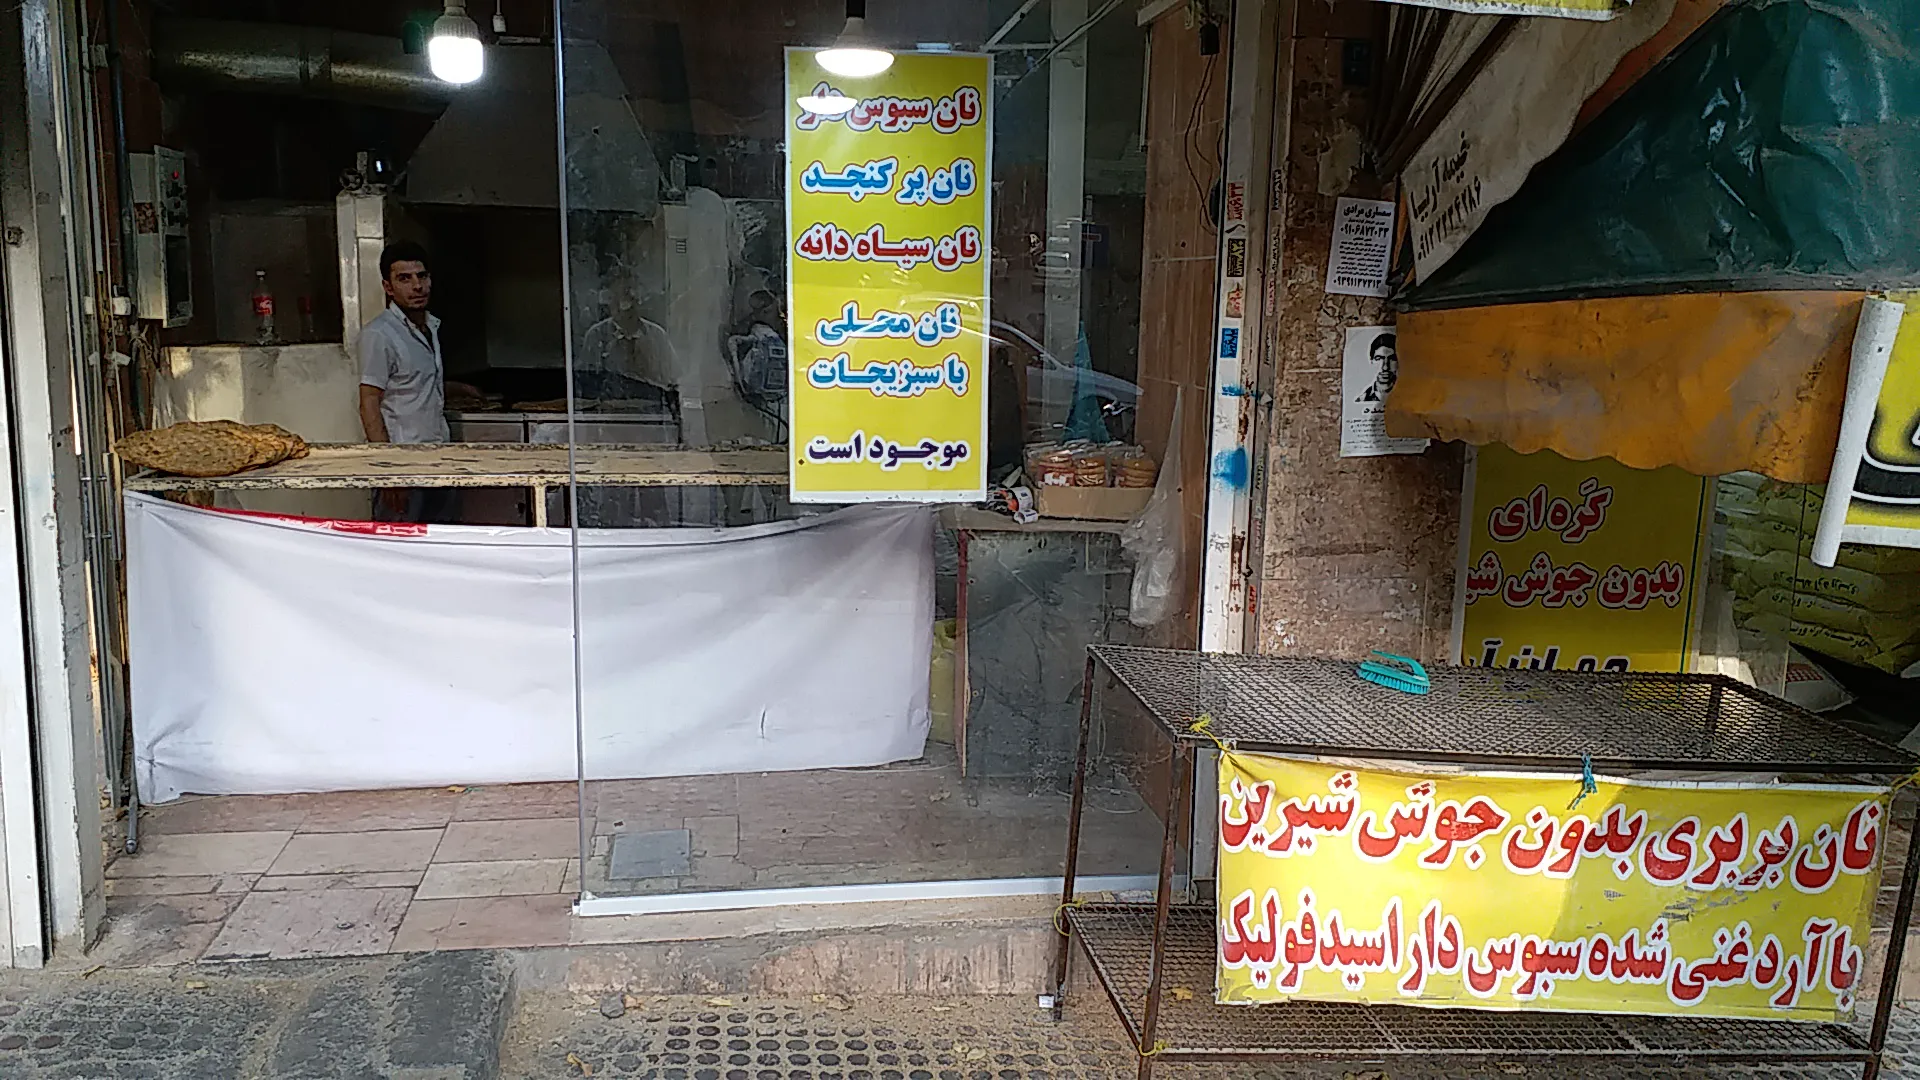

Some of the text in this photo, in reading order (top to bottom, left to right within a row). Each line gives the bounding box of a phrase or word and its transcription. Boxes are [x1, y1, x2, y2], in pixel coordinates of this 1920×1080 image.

[848, 97, 931, 130] سبوس
[933, 87, 980, 131] نان
[803, 159, 974, 203] نان پر کنجد
[1409, 155, 1441, 224] آریا
[798, 225, 980, 270] نان سیاه دانه
[817, 303, 960, 344] نان محلی
[809, 356, 967, 394] با سبزیجات
[806, 431, 970, 470] موجود است
[1505, 554, 1598, 606] جوش
[1599, 561, 1684, 608] بدون
[1219, 771, 1881, 891] نان بربری بدون جوش شیرین
[1219, 891, 1861, 1008] با آرد غنی شده سبوس دار اسید فولیک
